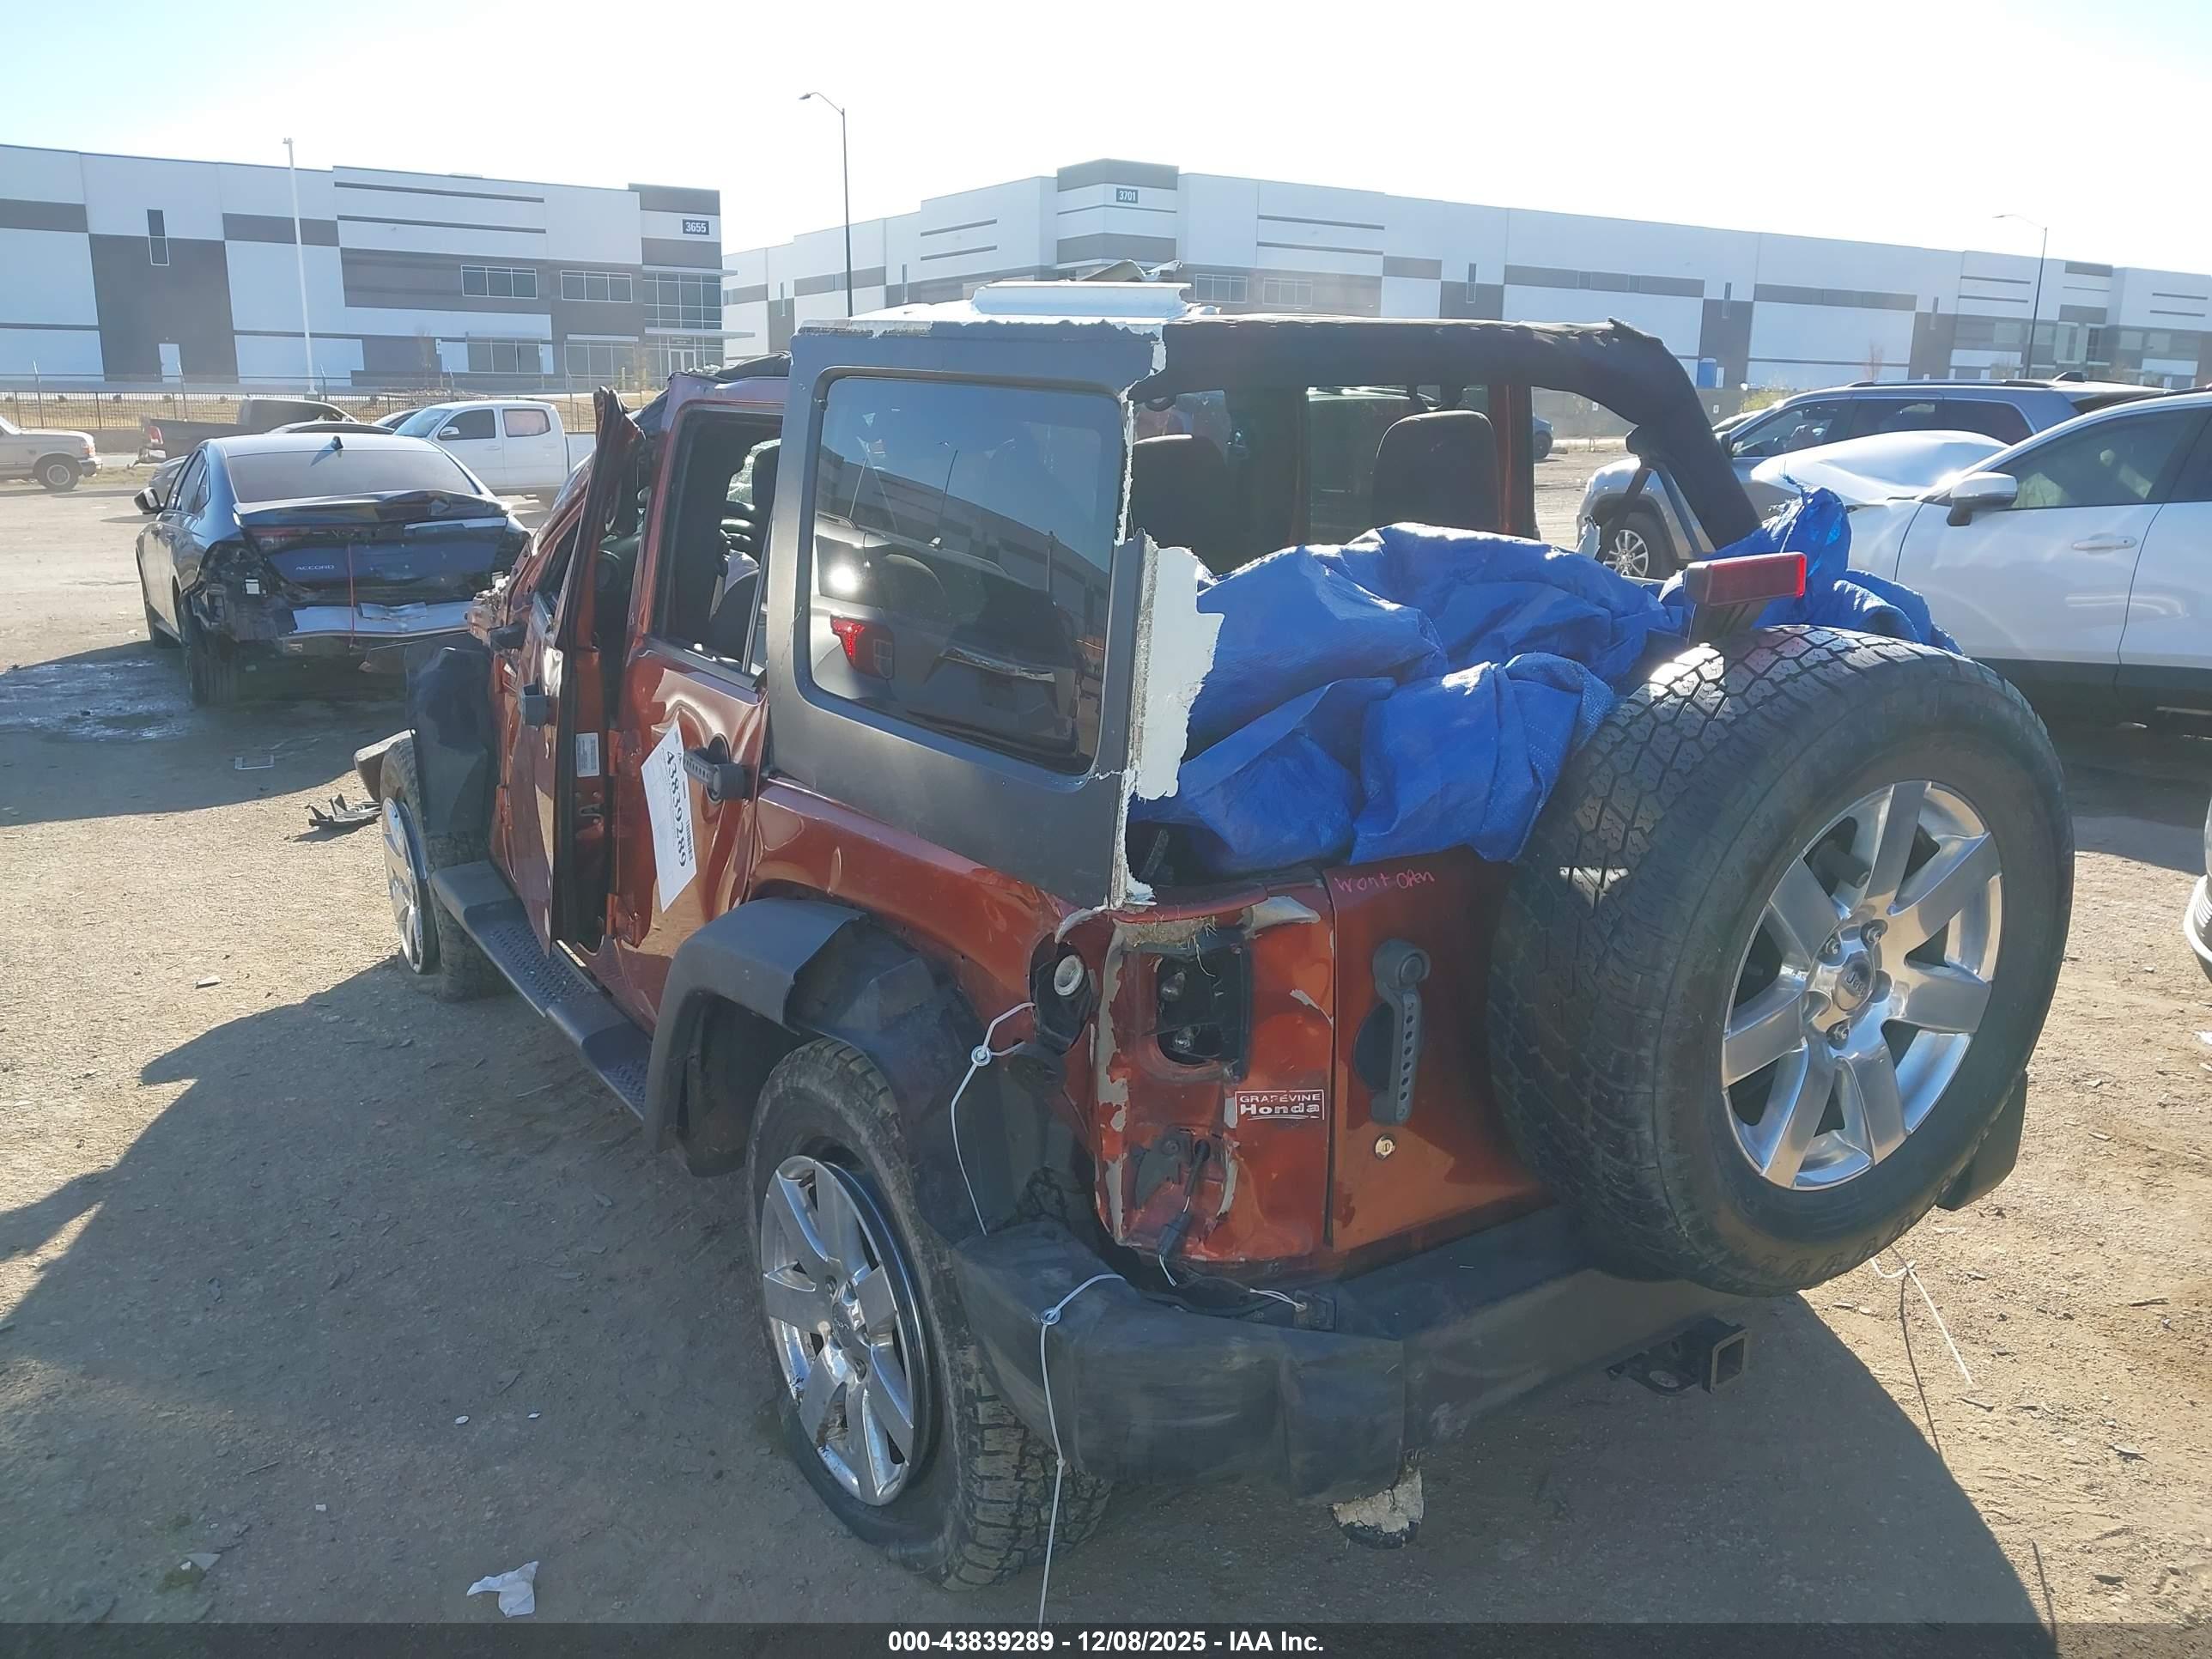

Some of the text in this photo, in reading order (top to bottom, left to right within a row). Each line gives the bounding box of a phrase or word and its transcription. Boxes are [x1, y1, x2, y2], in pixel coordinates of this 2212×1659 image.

[1119, 191, 1136, 201] 3701
[685, 222, 707, 233] 3655
[665, 750, 688, 867] 43839289
[1240, 1103, 1320, 1115] Honda
